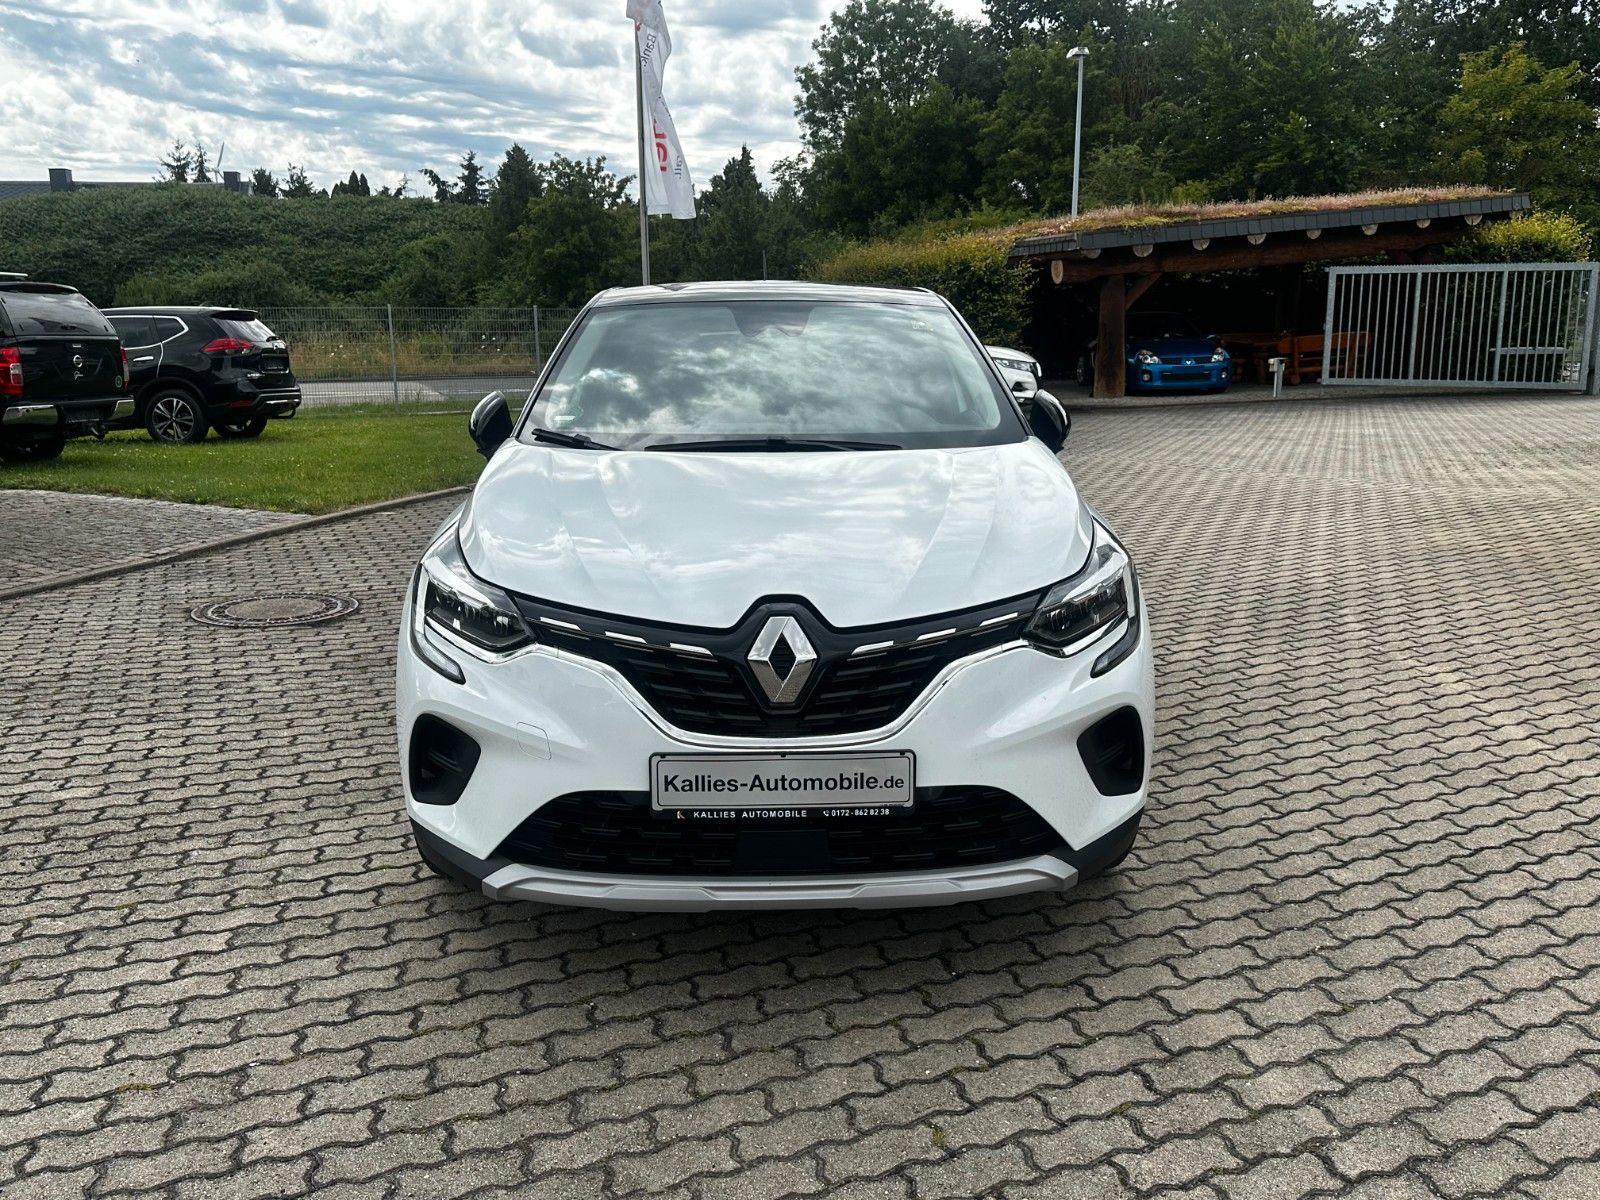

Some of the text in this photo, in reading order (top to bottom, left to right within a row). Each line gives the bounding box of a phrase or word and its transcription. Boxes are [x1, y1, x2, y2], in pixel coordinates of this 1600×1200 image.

[663, 772, 905, 793] Kallies-Automobile.de
[693, 811, 736, 819] KALLIES
[741, 810, 808, 818] AUTOMOBILE
